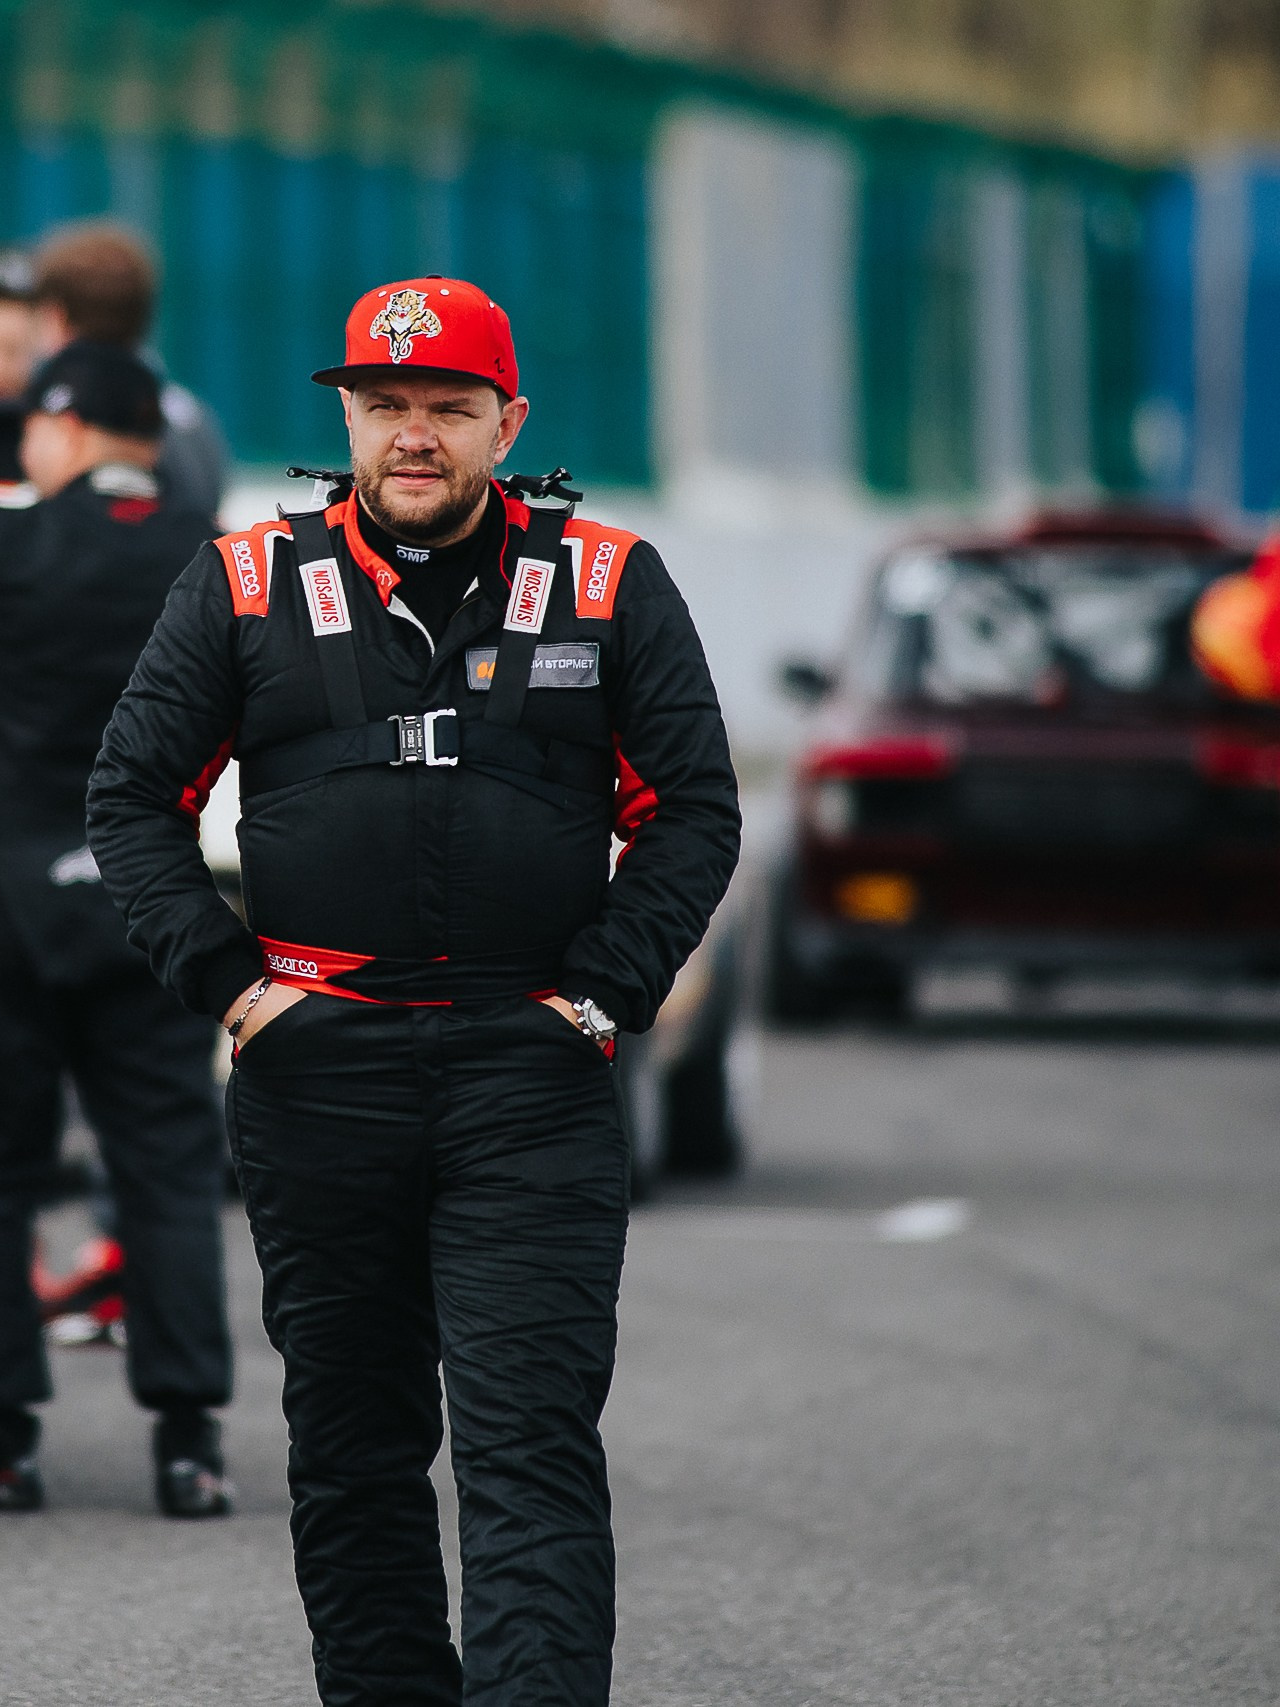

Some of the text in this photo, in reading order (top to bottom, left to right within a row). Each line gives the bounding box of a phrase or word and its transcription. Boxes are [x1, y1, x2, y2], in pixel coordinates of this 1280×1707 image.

[230, 540, 260, 598] sparco
[396, 549, 430, 563] OMP
[586, 541, 618, 603] sparco
[311, 570, 339, 623] SIMPSON
[516, 568, 543, 623] SIMPSON
[545, 658, 595, 670] ВТОРМЕТ
[267, 953, 319, 978] sparco
